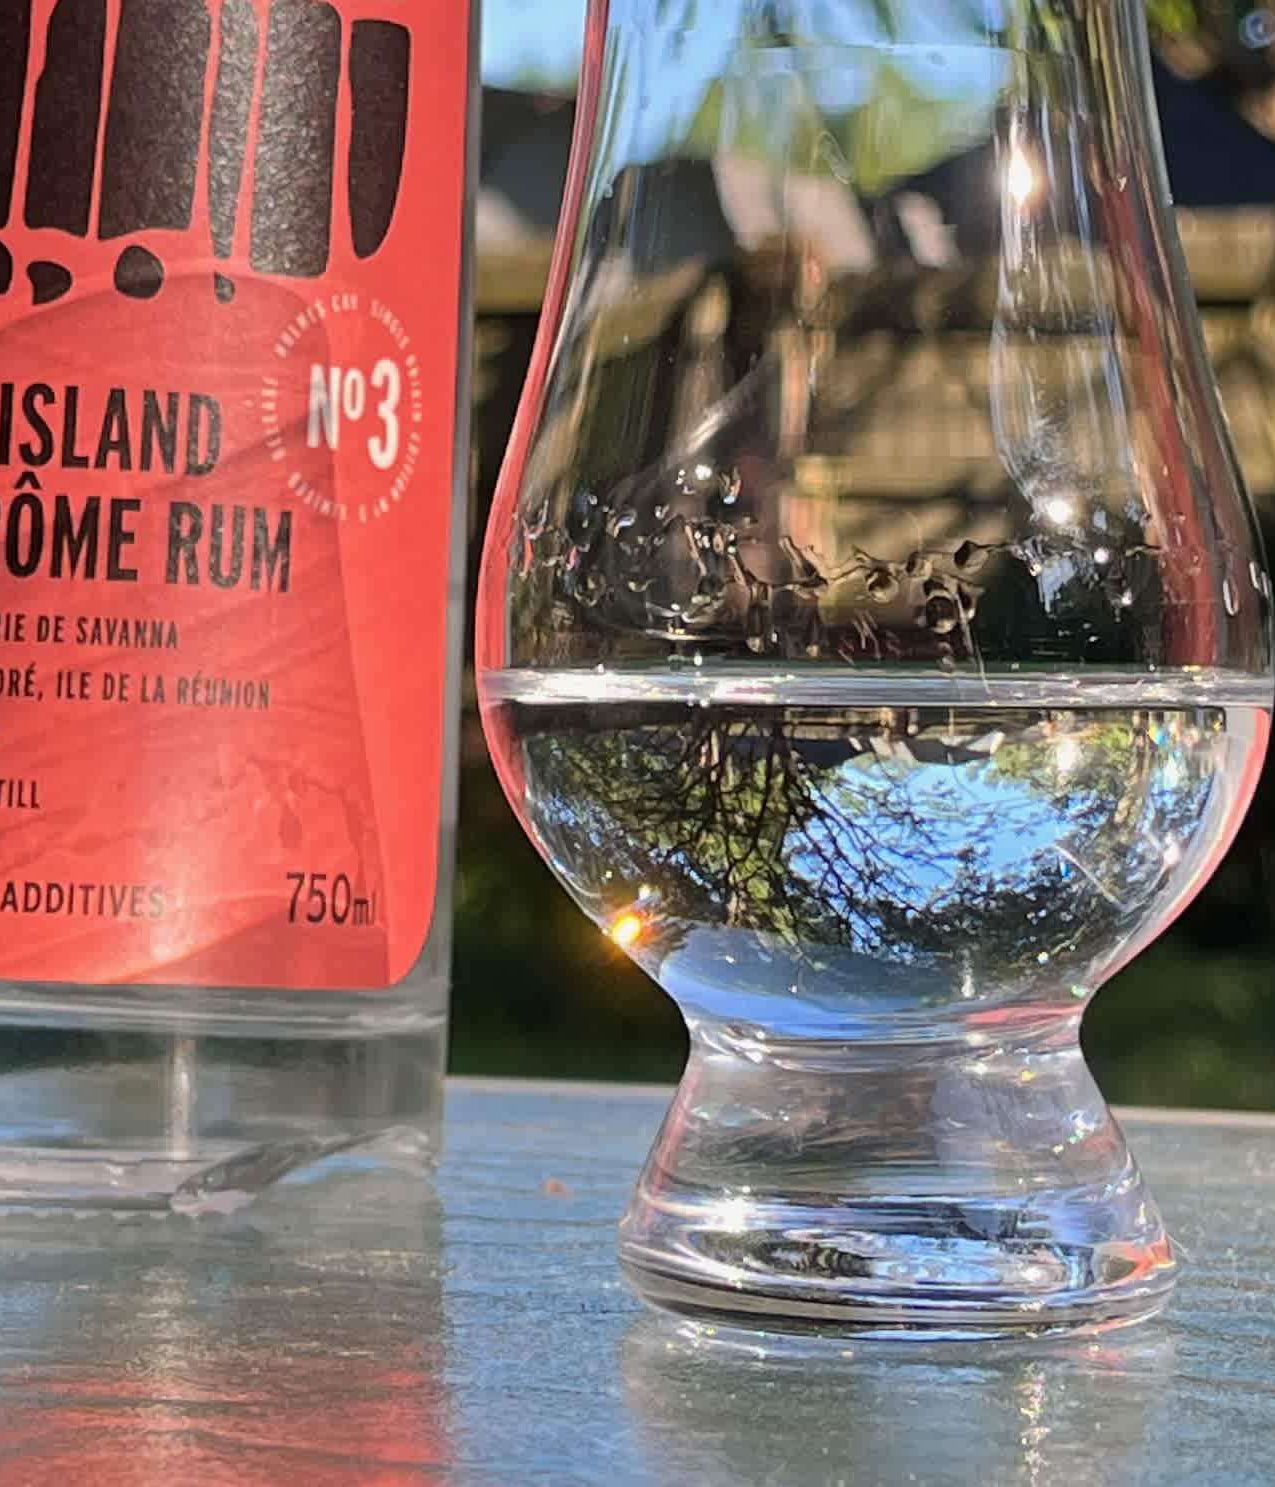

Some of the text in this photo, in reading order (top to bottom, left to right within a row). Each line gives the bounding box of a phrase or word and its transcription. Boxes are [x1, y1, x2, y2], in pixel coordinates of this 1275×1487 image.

[164, 500, 294, 594] RUM
[36, 615, 65, 644] DE
[75, 617, 179, 650] SAVANNA
[56, 671, 92, 702] ILE
[101, 672, 131, 704] DE
[139, 675, 167, 706] LA
[175, 672, 272, 711] RÉUNION
[0, 879, 166, 920] ADDITIVES
